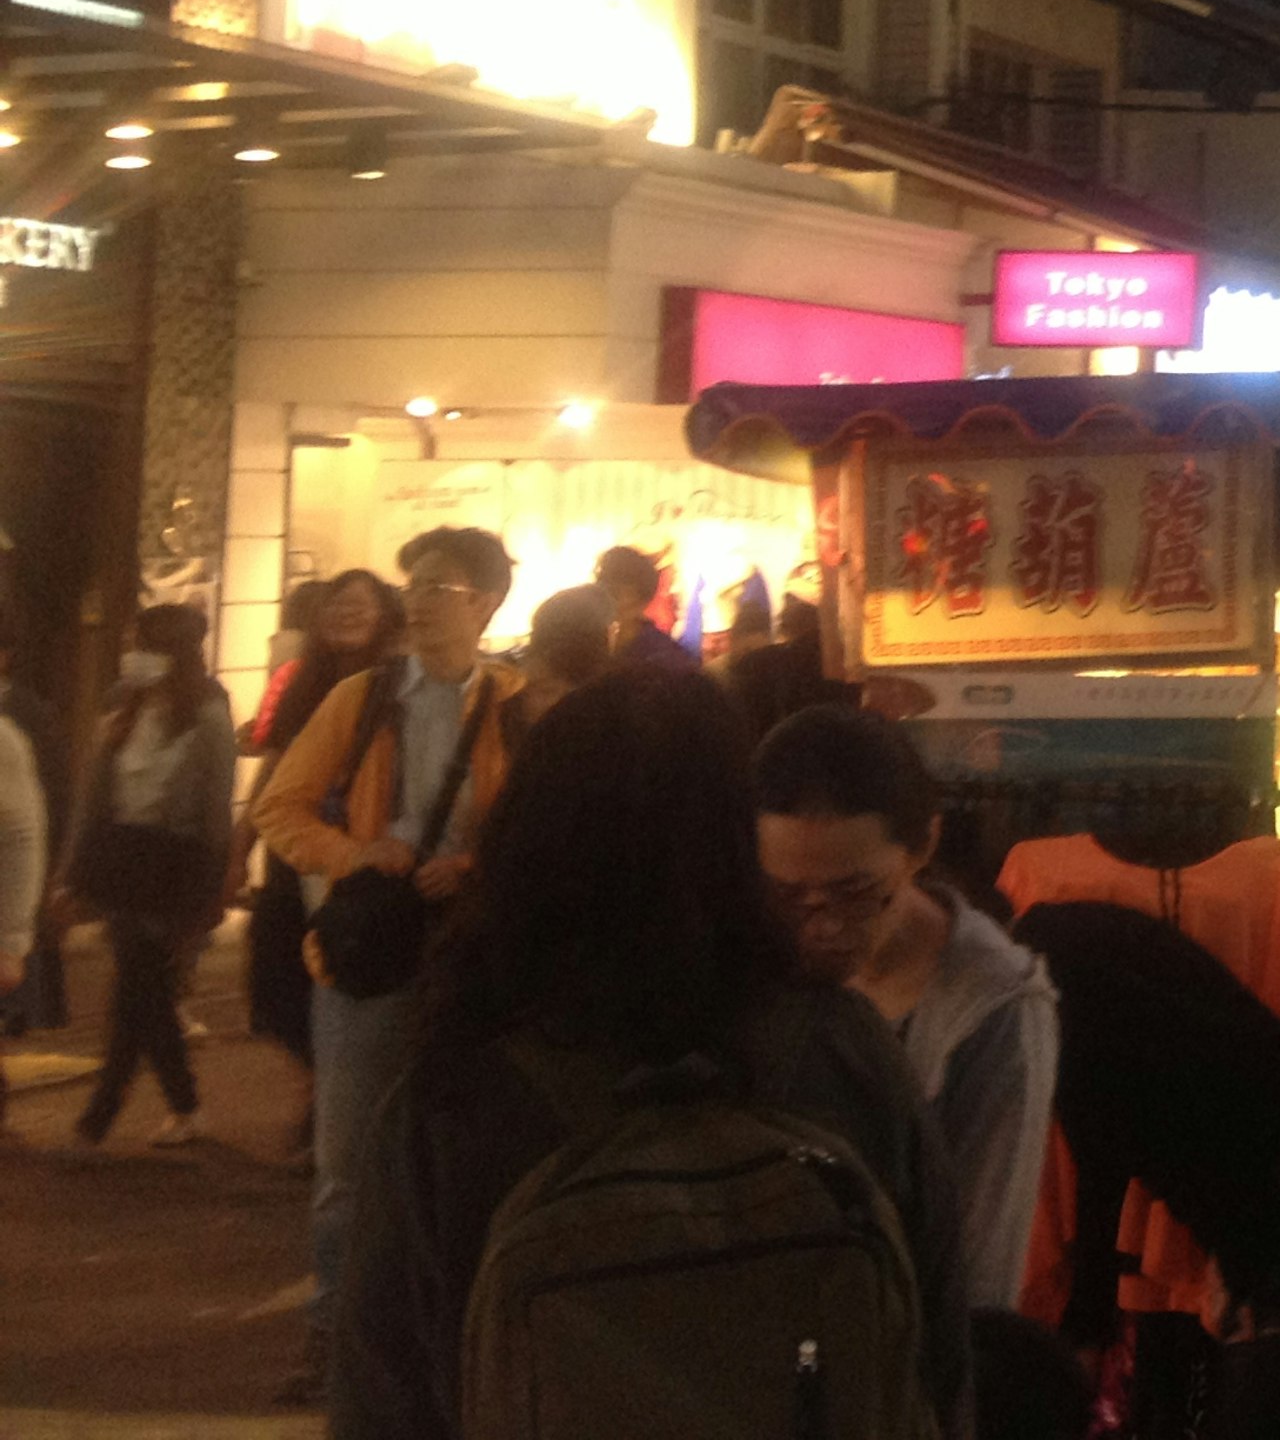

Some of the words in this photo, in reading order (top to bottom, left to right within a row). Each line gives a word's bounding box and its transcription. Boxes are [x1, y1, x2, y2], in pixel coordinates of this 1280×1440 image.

[1046, 270, 1148, 302] Tokyo
[1025, 303, 1165, 329] Fashion
[895, 465, 1218, 620] 糖葫蘆
